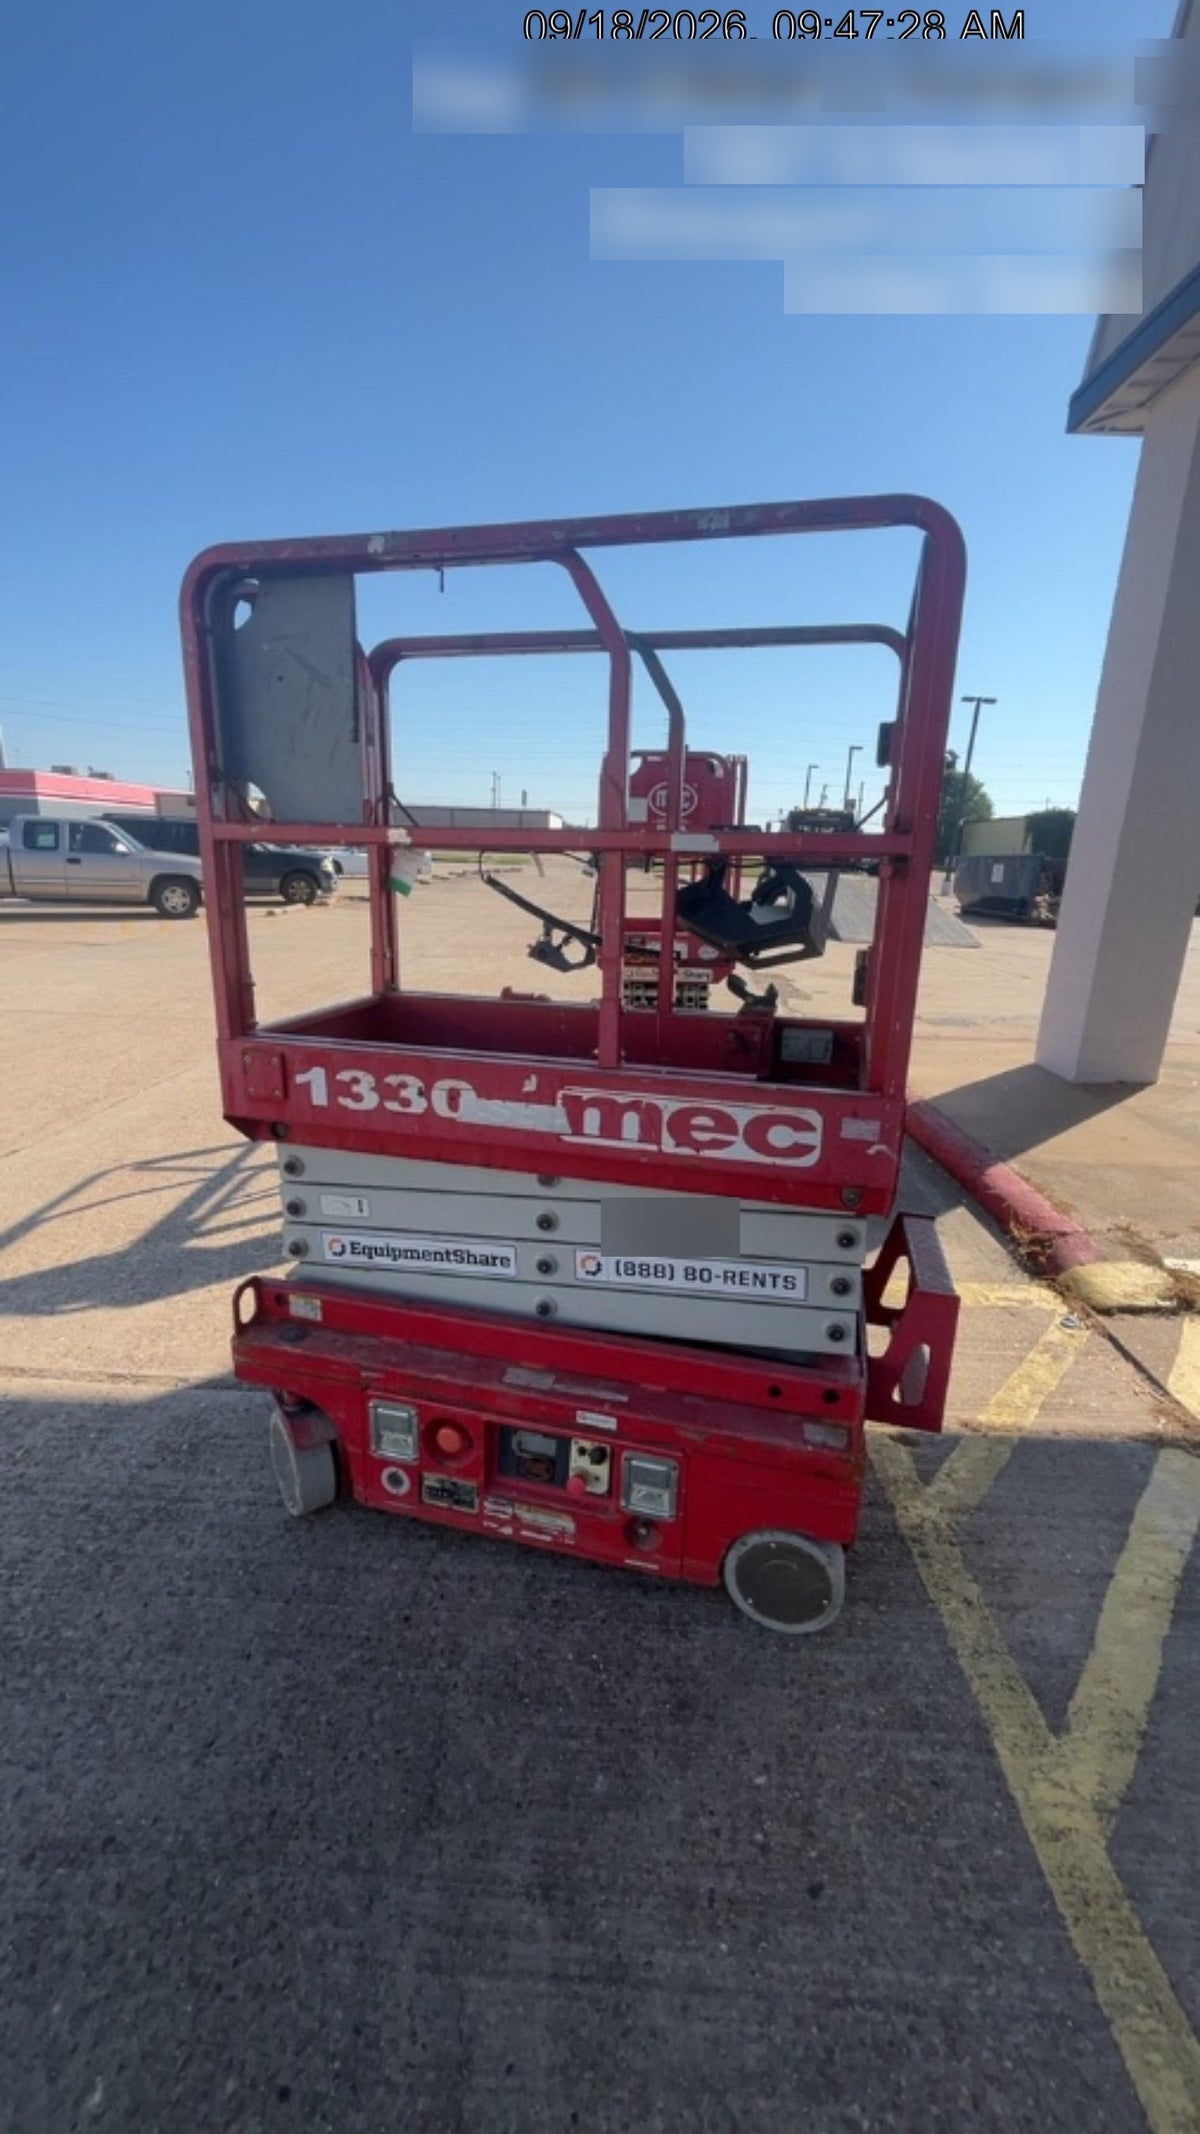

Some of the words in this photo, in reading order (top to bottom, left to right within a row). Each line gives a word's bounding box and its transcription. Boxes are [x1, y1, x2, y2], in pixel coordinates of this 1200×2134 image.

[295, 1066, 479, 1118] 1330
[349, 1241, 511, 1269] EquipmentShare
[615, 1260, 675, 1281] (888)
[683, 1265, 797, 1291] 80-RENTS
